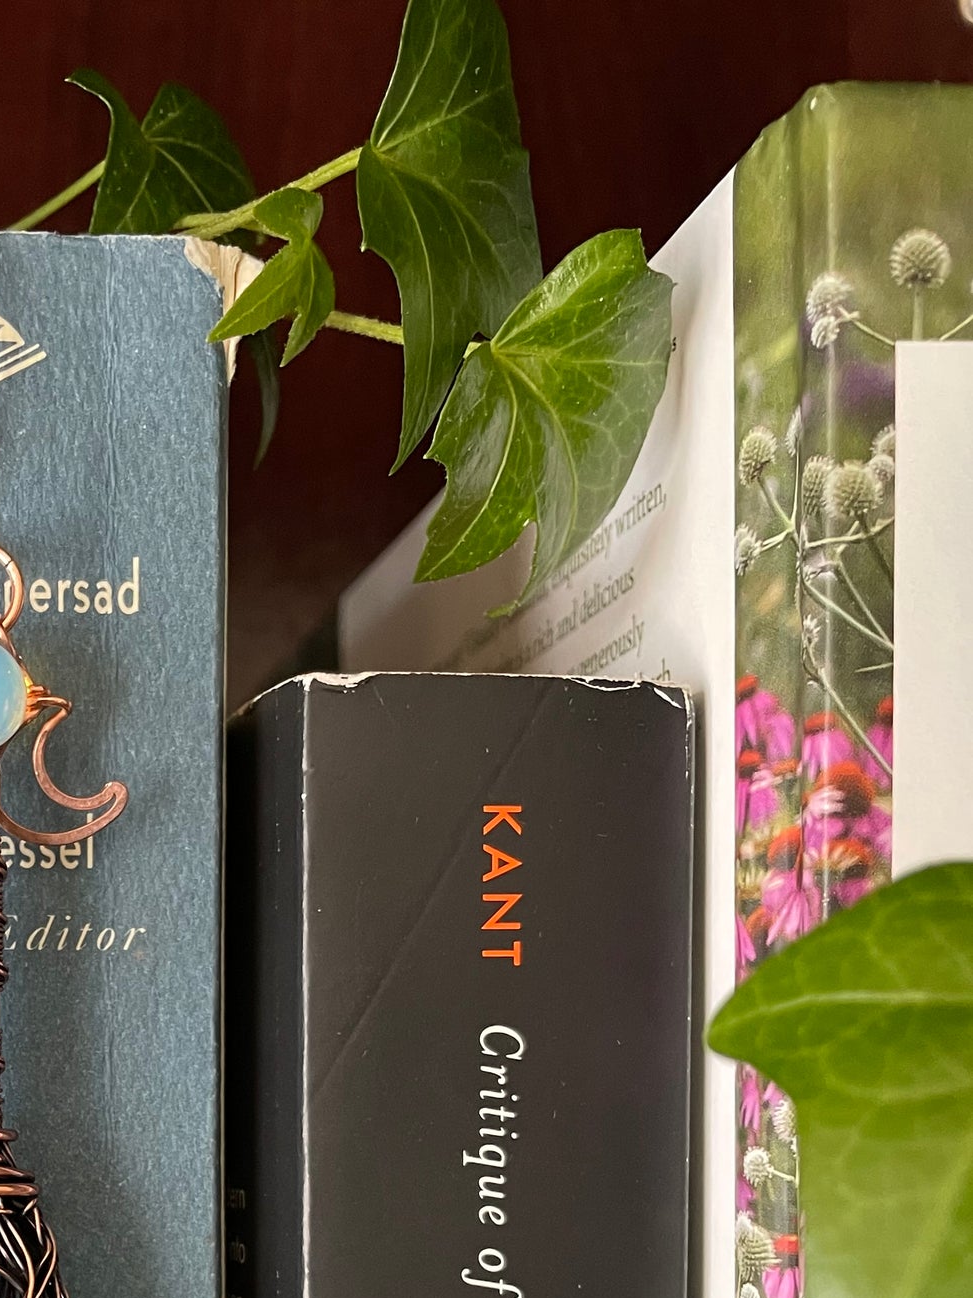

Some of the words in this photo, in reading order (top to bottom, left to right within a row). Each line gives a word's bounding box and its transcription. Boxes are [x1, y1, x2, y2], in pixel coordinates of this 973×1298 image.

[579, 566, 636, 626] delicious
[482, 804, 524, 967] KANT
[462, 1024, 526, 1227] Critique
